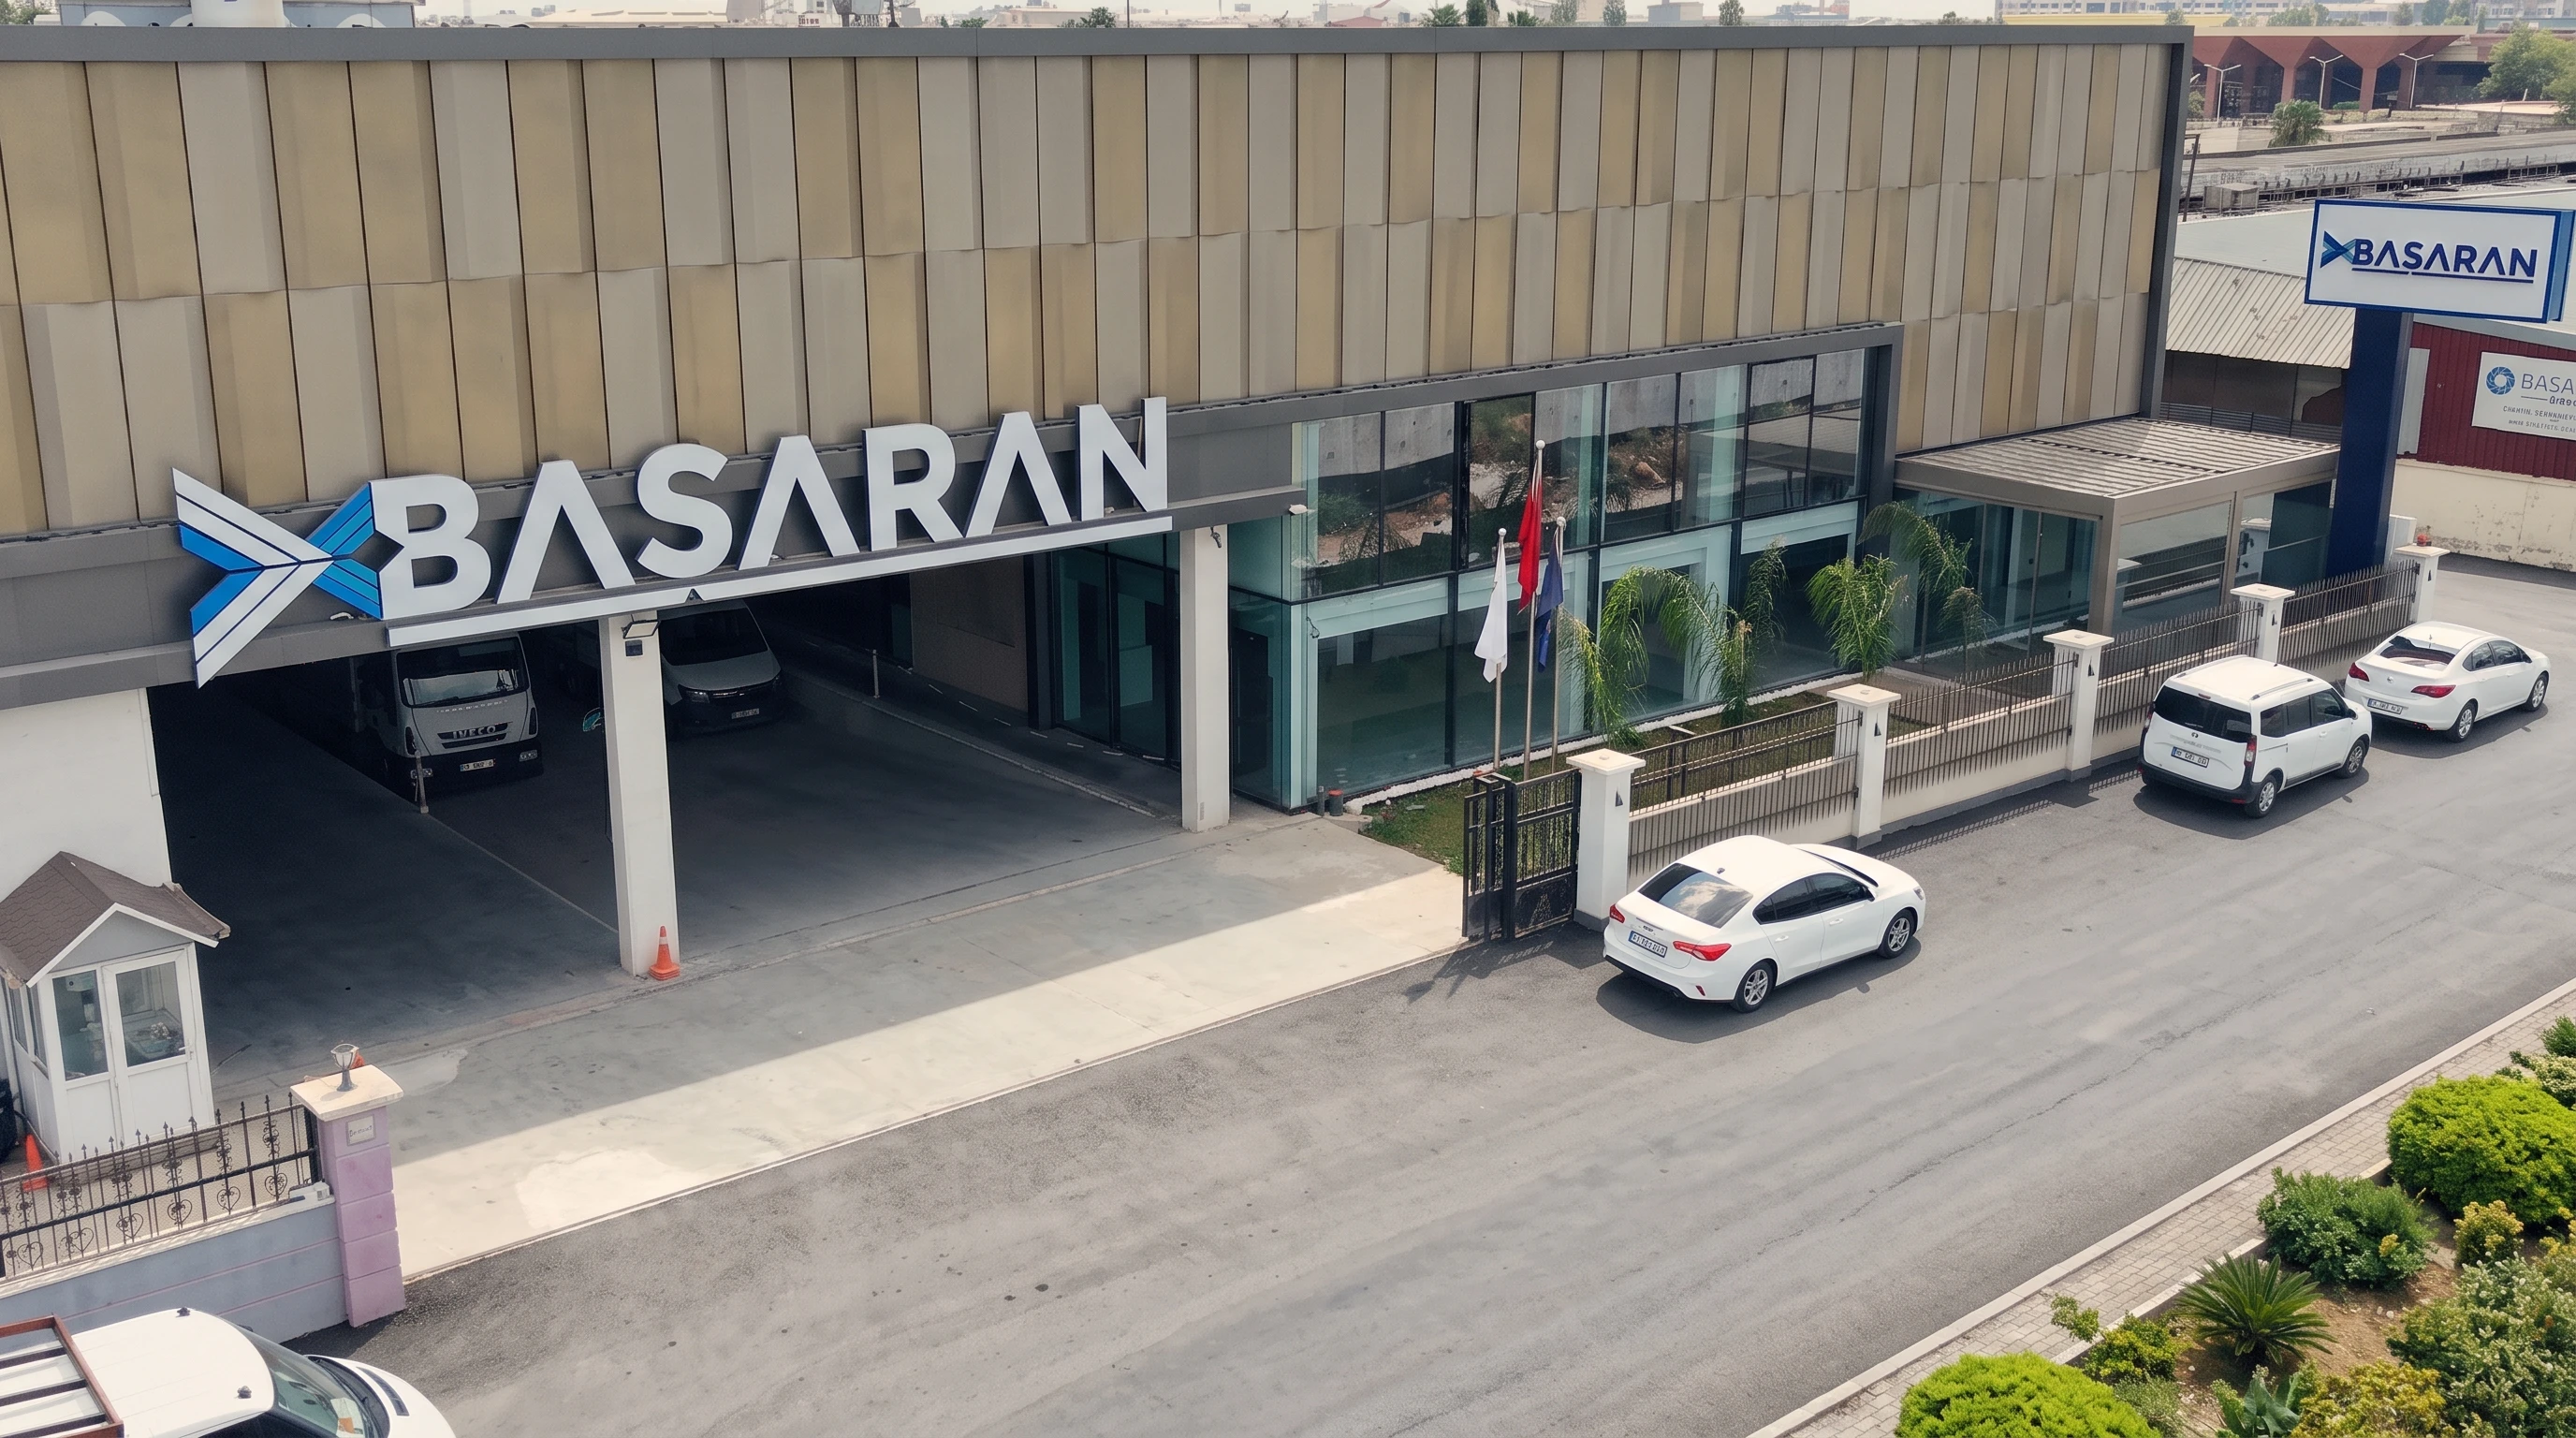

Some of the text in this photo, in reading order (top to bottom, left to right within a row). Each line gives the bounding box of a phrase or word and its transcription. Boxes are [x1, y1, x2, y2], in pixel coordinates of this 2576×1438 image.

[2351, 238, 2538, 278] BASARAN
[368, 396, 1168, 621] BASARAN
[452, 725, 496, 740] IVECO
